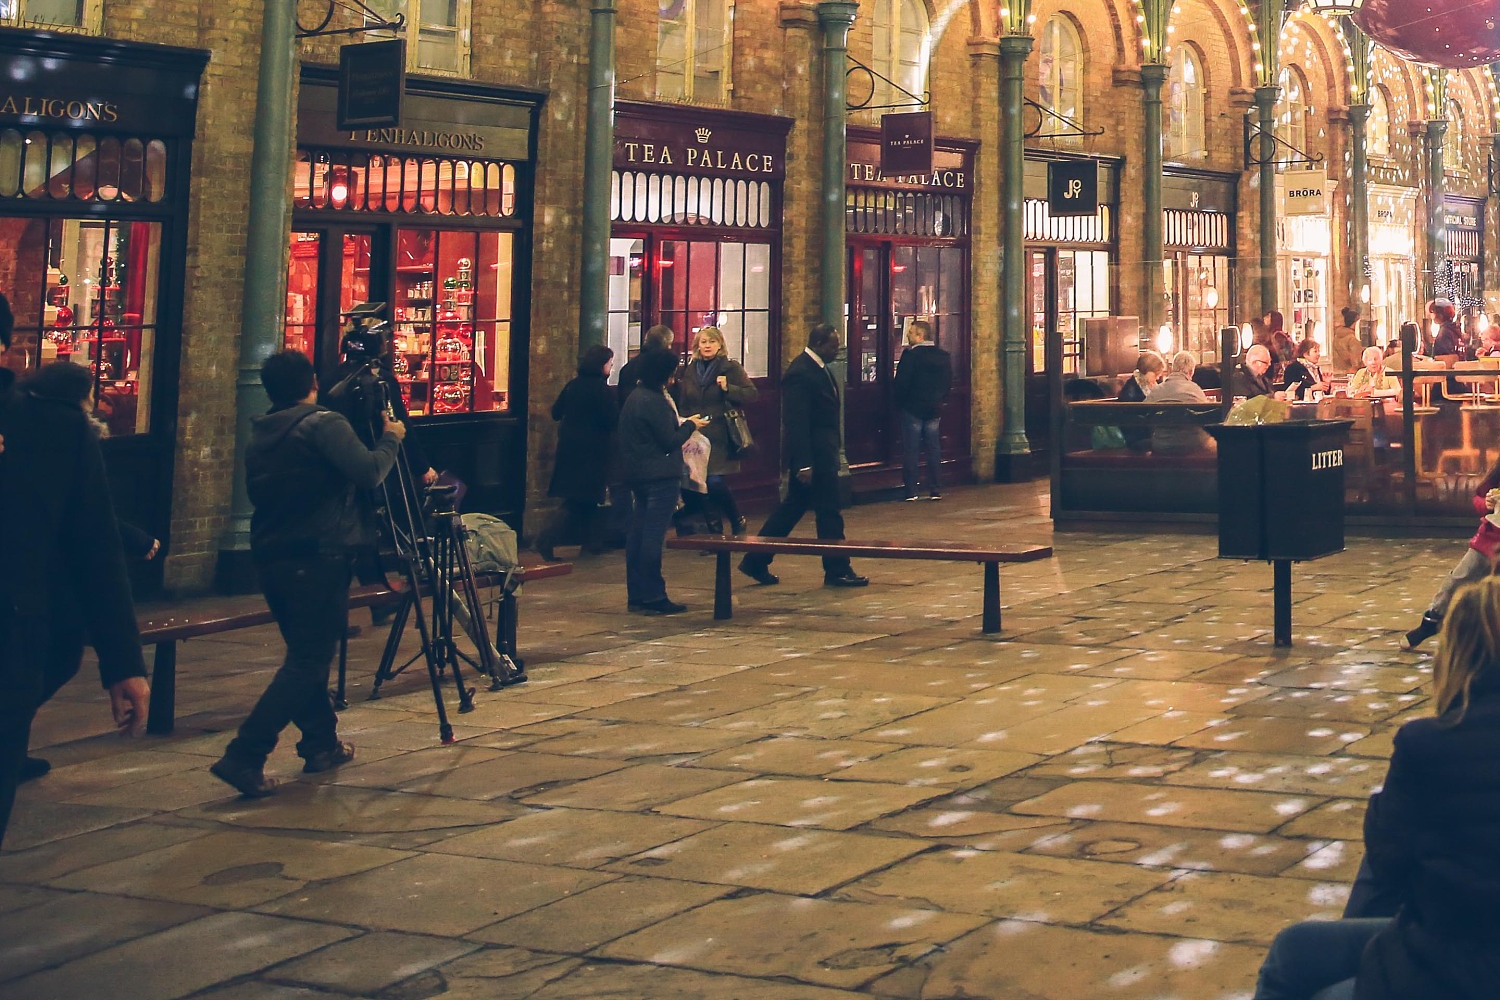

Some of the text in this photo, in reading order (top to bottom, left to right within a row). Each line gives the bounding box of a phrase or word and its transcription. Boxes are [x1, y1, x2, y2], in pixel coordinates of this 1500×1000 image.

[0, 96, 118, 122] ALIGON'S
[624, 142, 773, 172] TEA PALACE
[1063, 179, 1082, 199] JOY
[1312, 449, 1343, 470] LITTER
